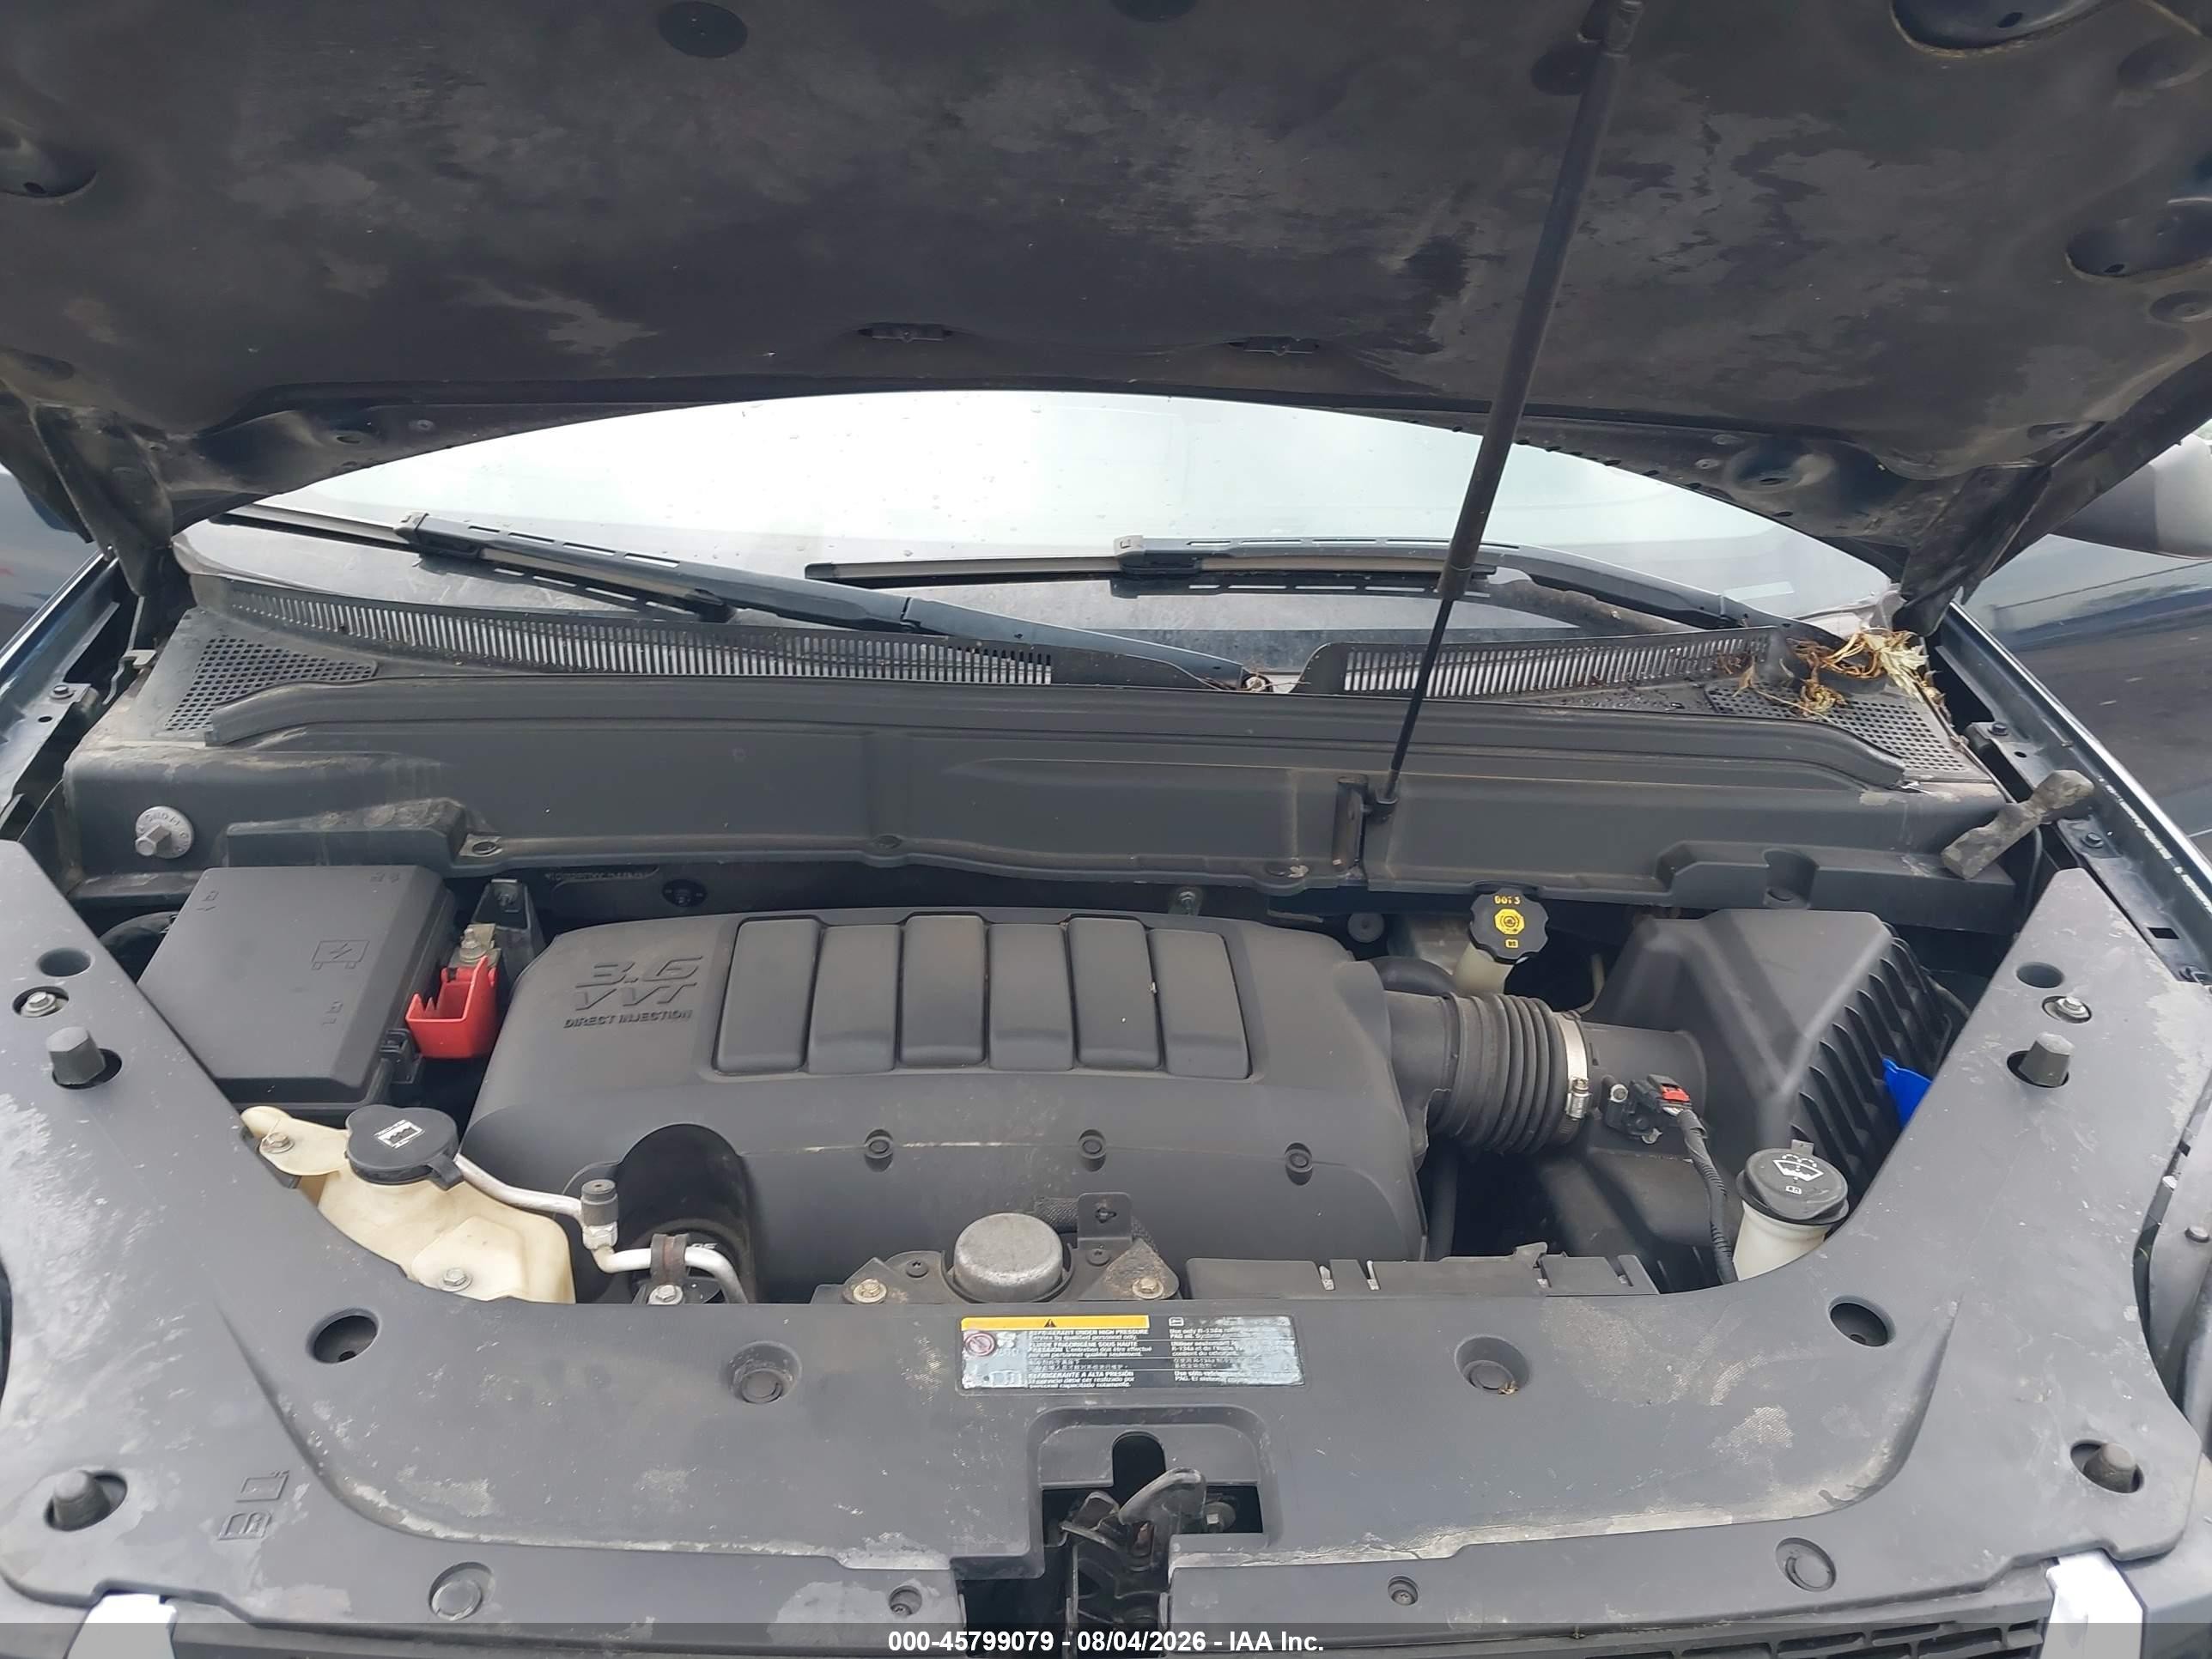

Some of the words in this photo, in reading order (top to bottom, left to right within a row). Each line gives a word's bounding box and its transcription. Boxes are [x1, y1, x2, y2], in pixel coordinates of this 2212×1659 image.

[575, 956, 703, 988] 3.6
[574, 982, 697, 1011] VVT
[563, 1014, 617, 1029] DIRECT
[617, 1008, 693, 1024] INJECTION
